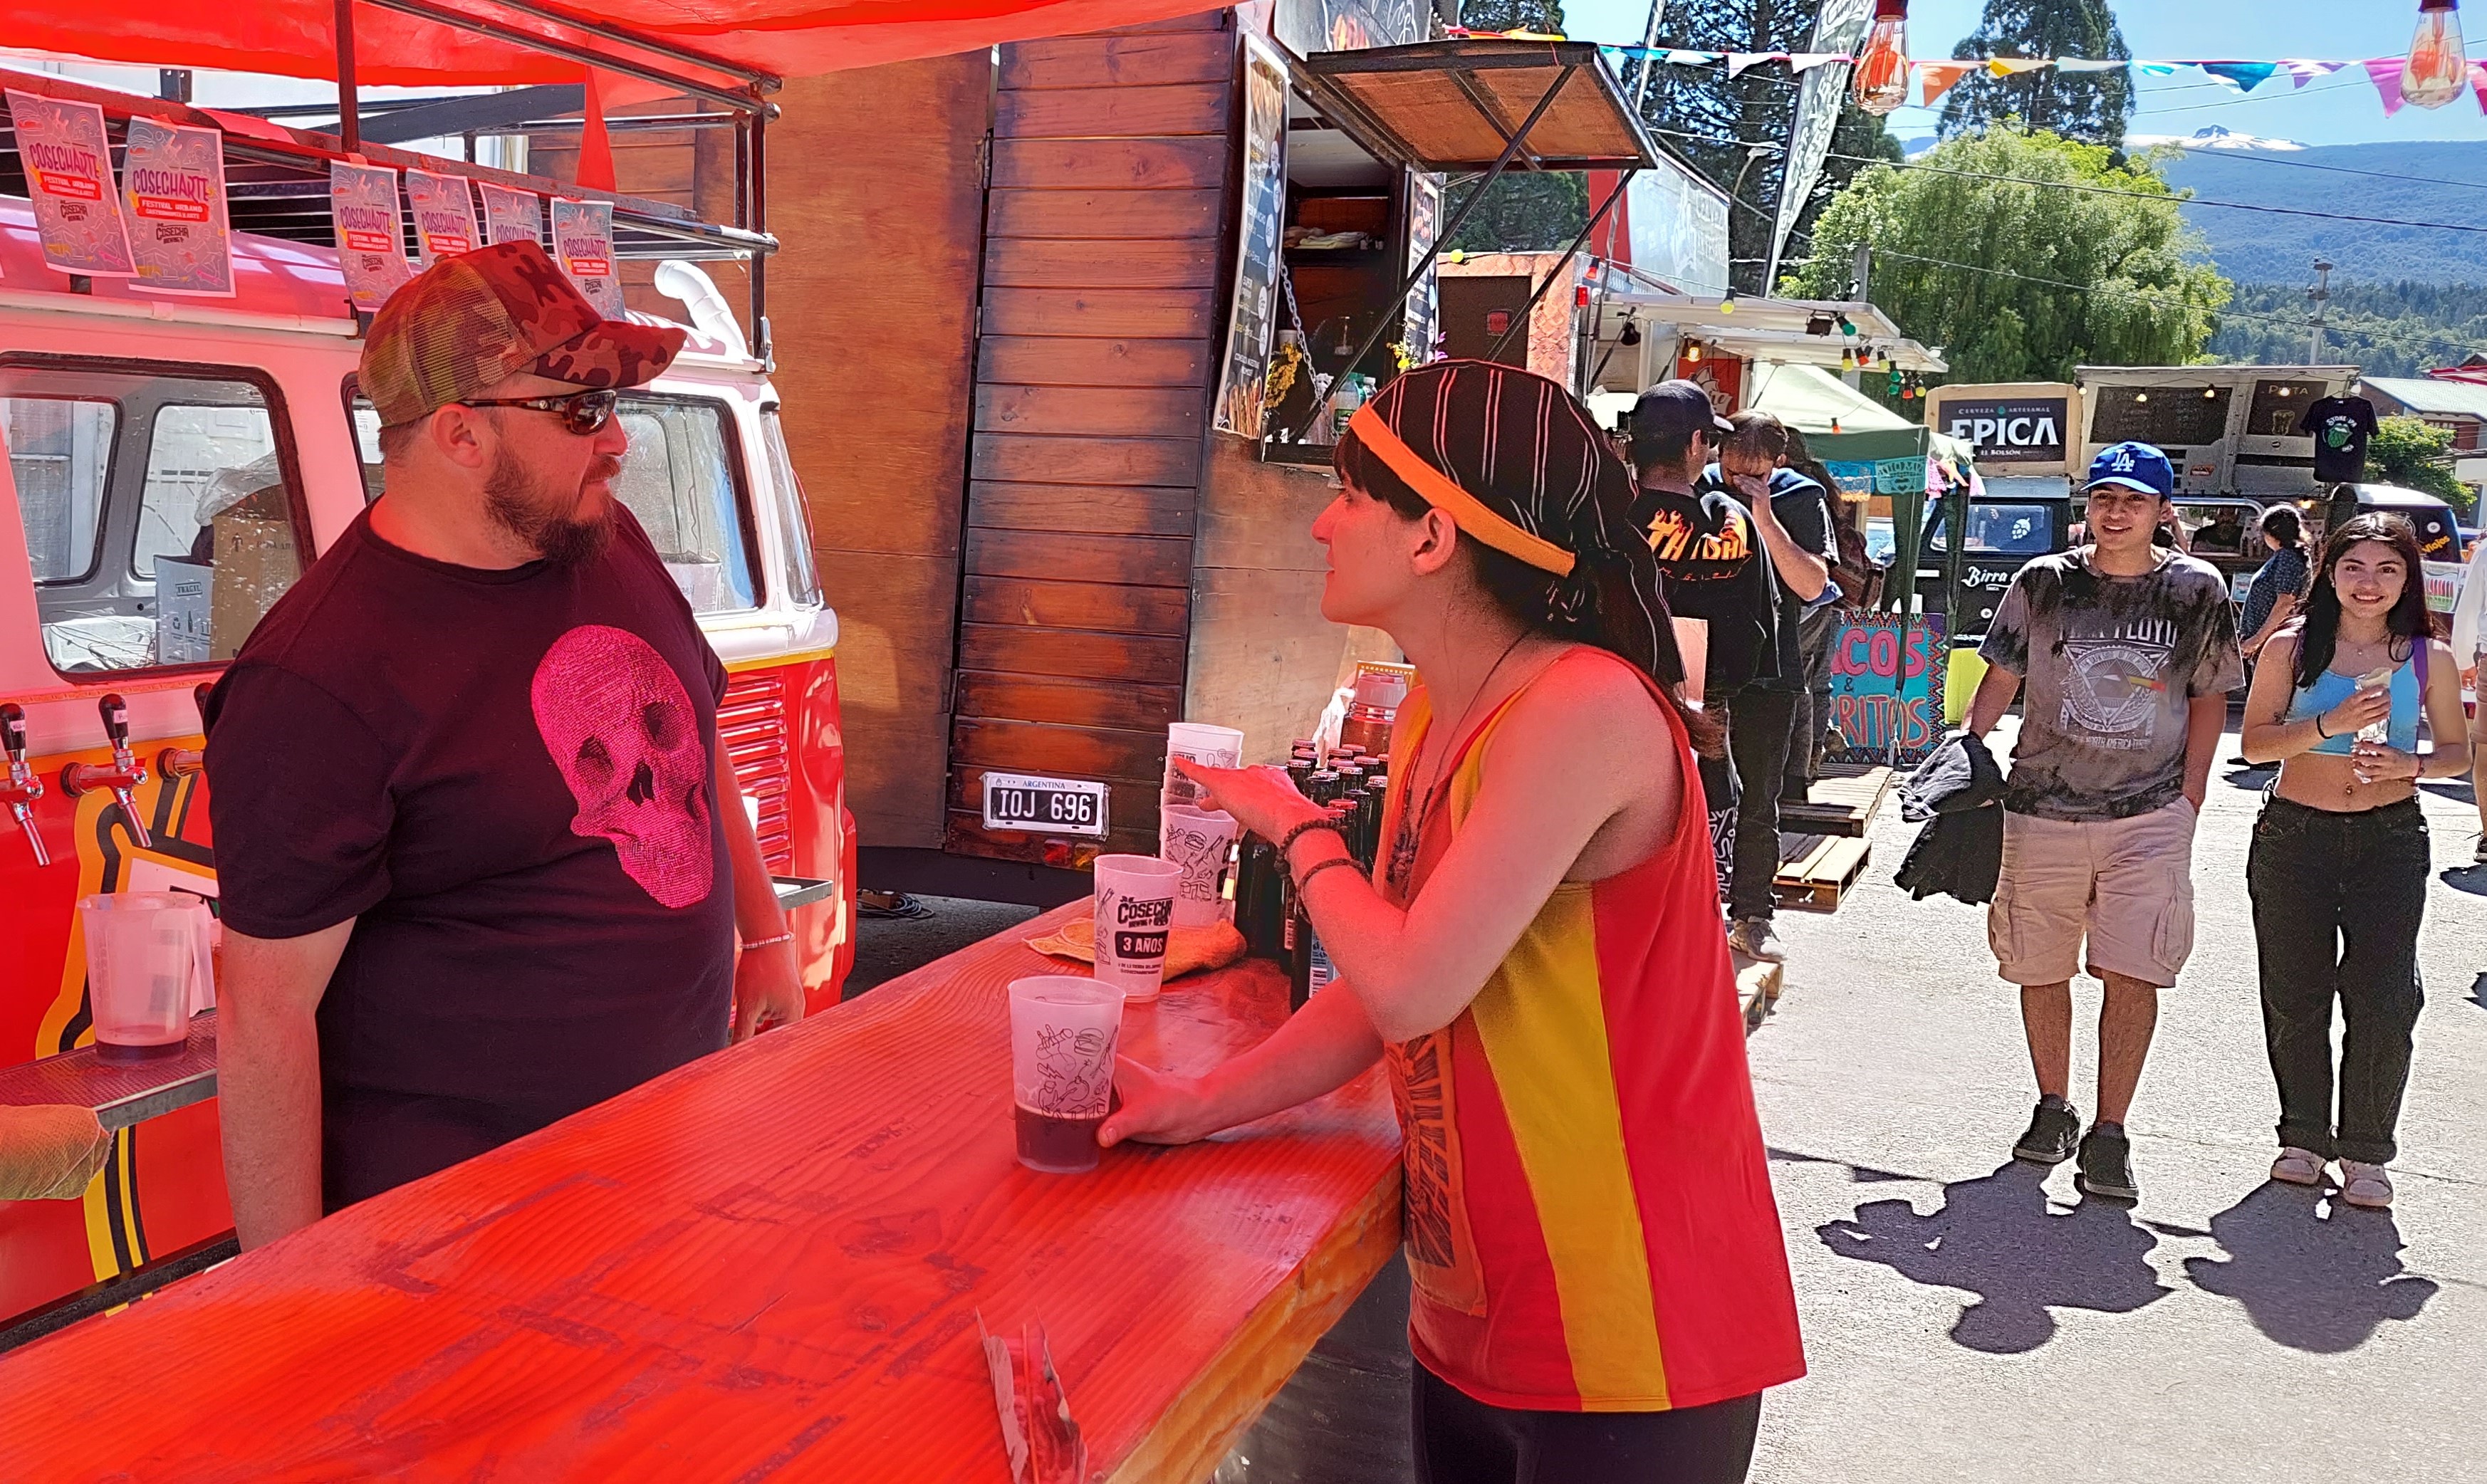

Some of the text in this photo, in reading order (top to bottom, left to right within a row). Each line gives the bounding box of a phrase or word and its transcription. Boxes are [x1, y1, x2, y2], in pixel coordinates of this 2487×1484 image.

[29, 142, 100, 180] COSECHARTE
[133, 168, 209, 204] COSECHARTE
[142, 199, 173, 209] FESTIVAL
[340, 206, 392, 236] COSECHARTE
[156, 226, 189, 241] COSECHA
[2268, 385, 2308, 394] PTA
[2111, 449, 2135, 472] LA
[1961, 566, 2008, 587] Birra
[1023, 780, 1065, 789] ARGENTINA
[1050, 793, 1091, 822] 696
[1117, 899, 1173, 924] COSECHA
[1122, 937, 1164, 953] 3 AÑOS
